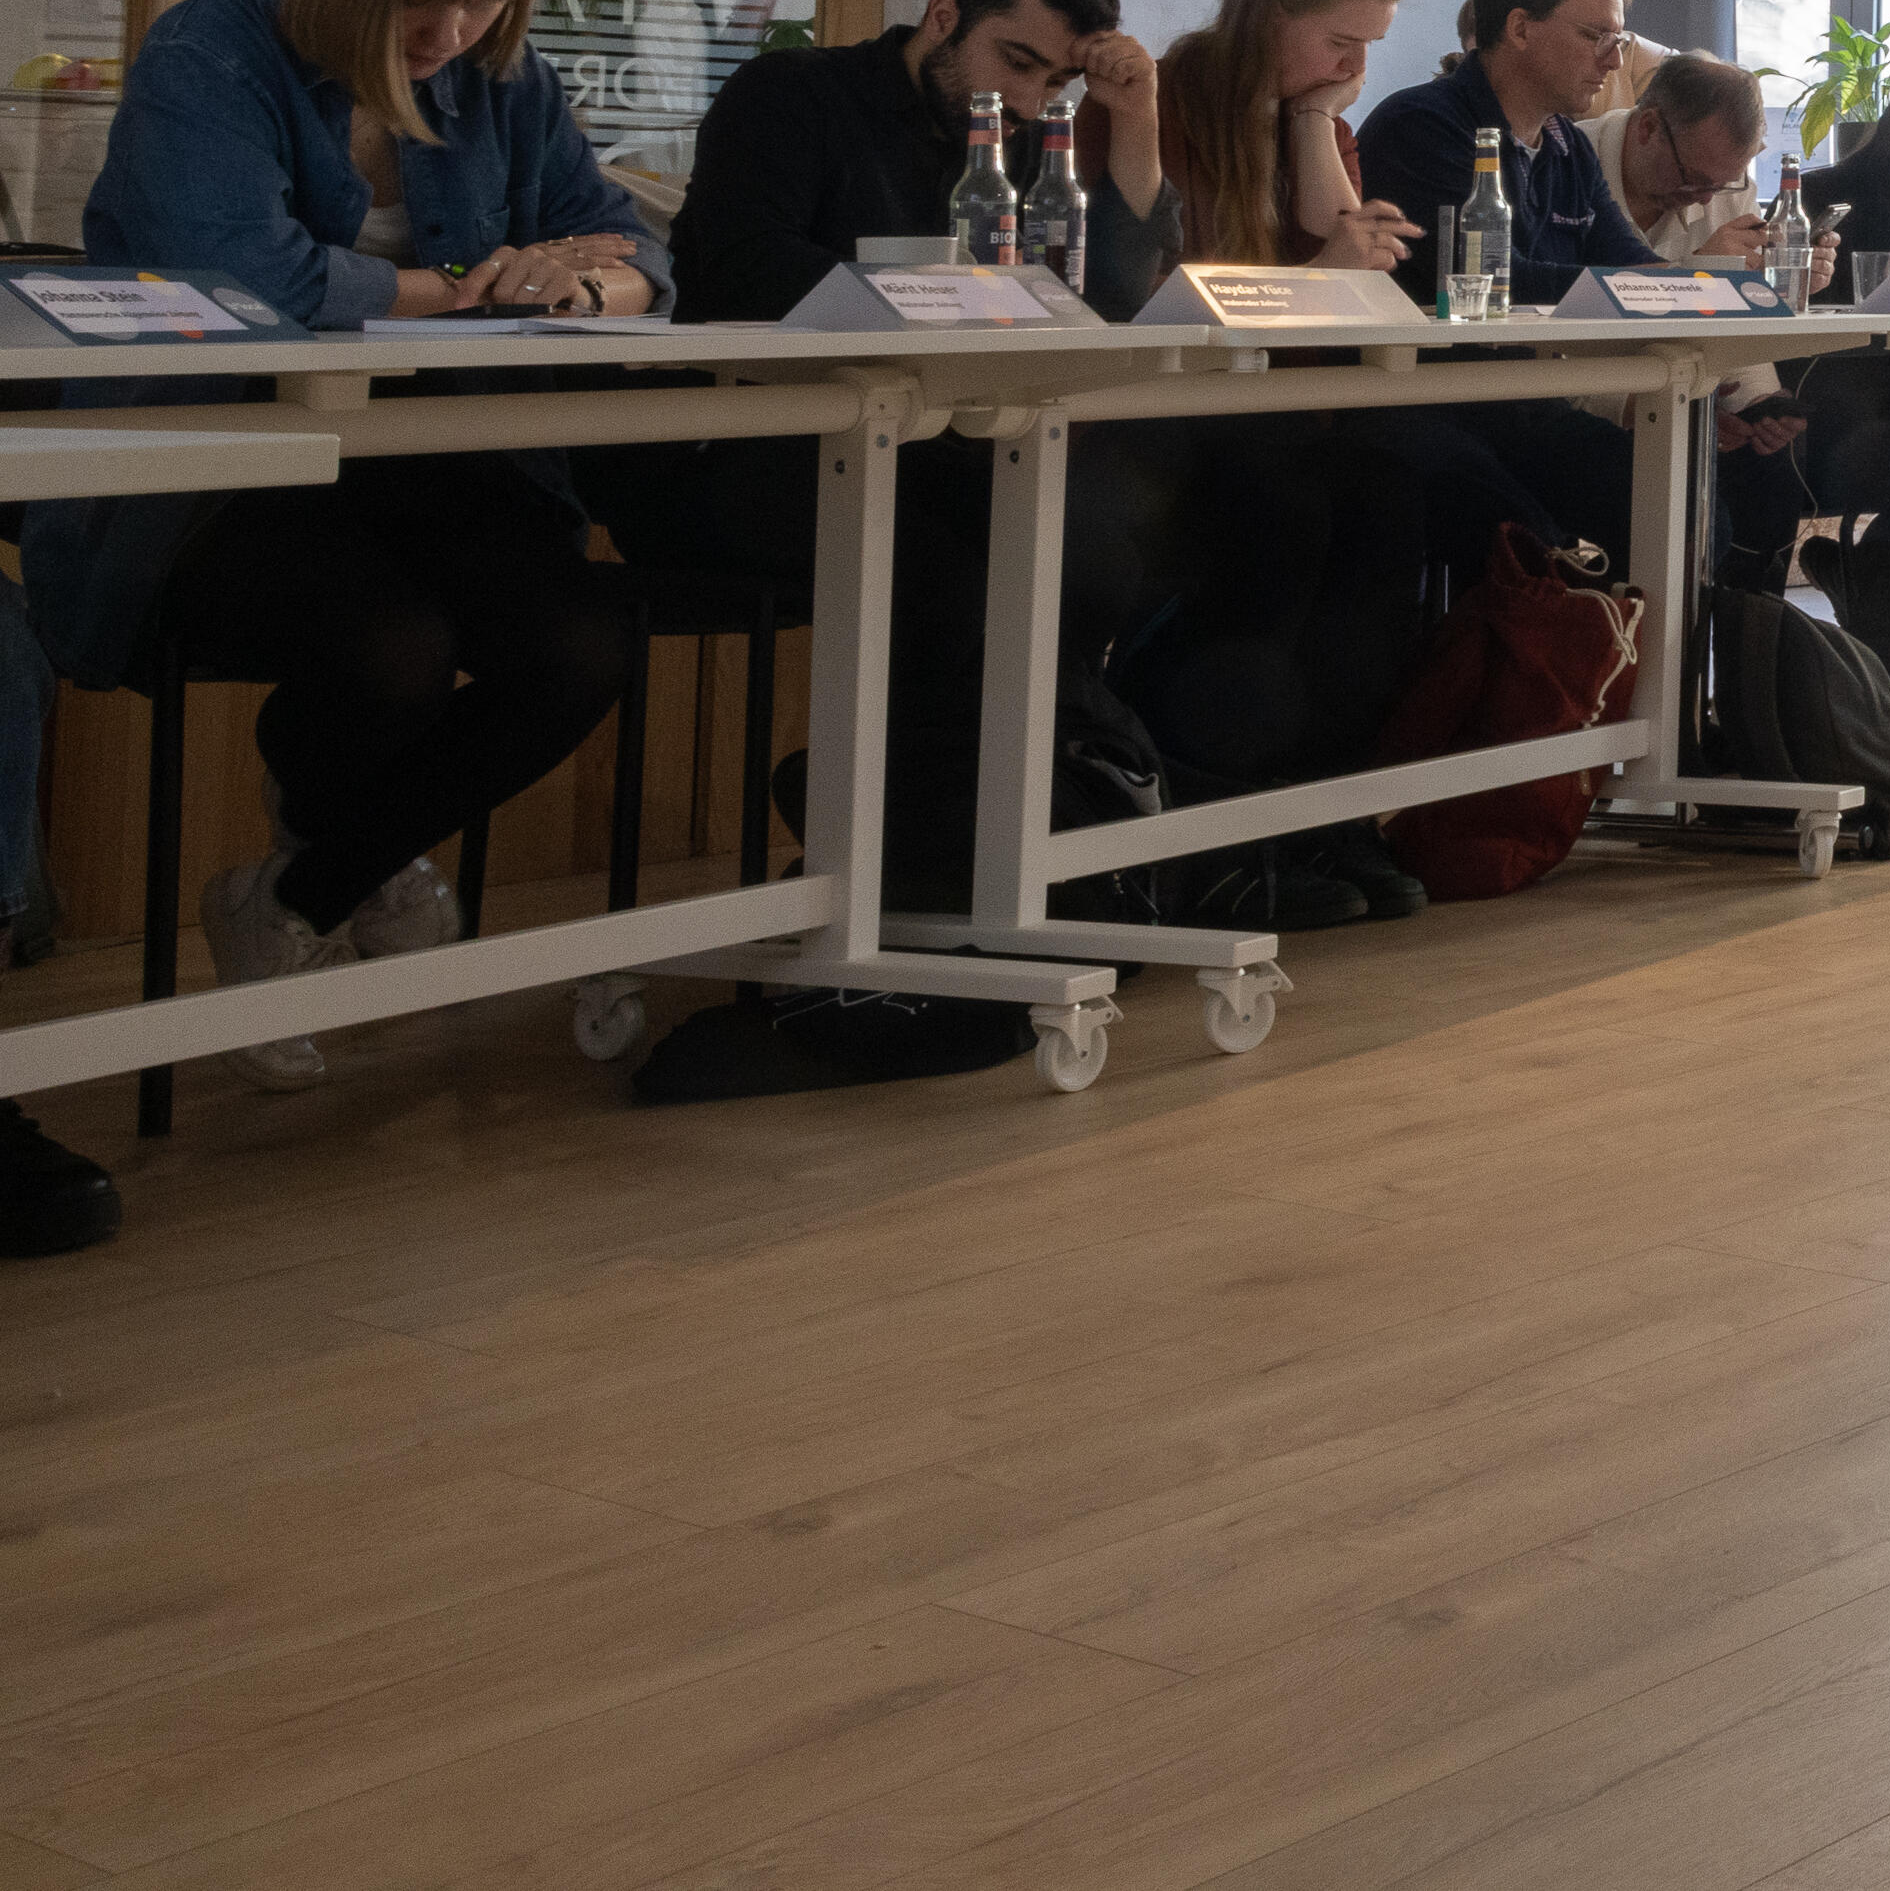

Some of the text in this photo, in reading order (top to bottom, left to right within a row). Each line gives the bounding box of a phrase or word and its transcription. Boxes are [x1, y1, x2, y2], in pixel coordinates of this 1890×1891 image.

[1209, 284, 1294, 297] Haydar Yüce
[1614, 282, 1704, 292] Johanna Scheele
[32, 288, 147, 304] Johanna Stein
